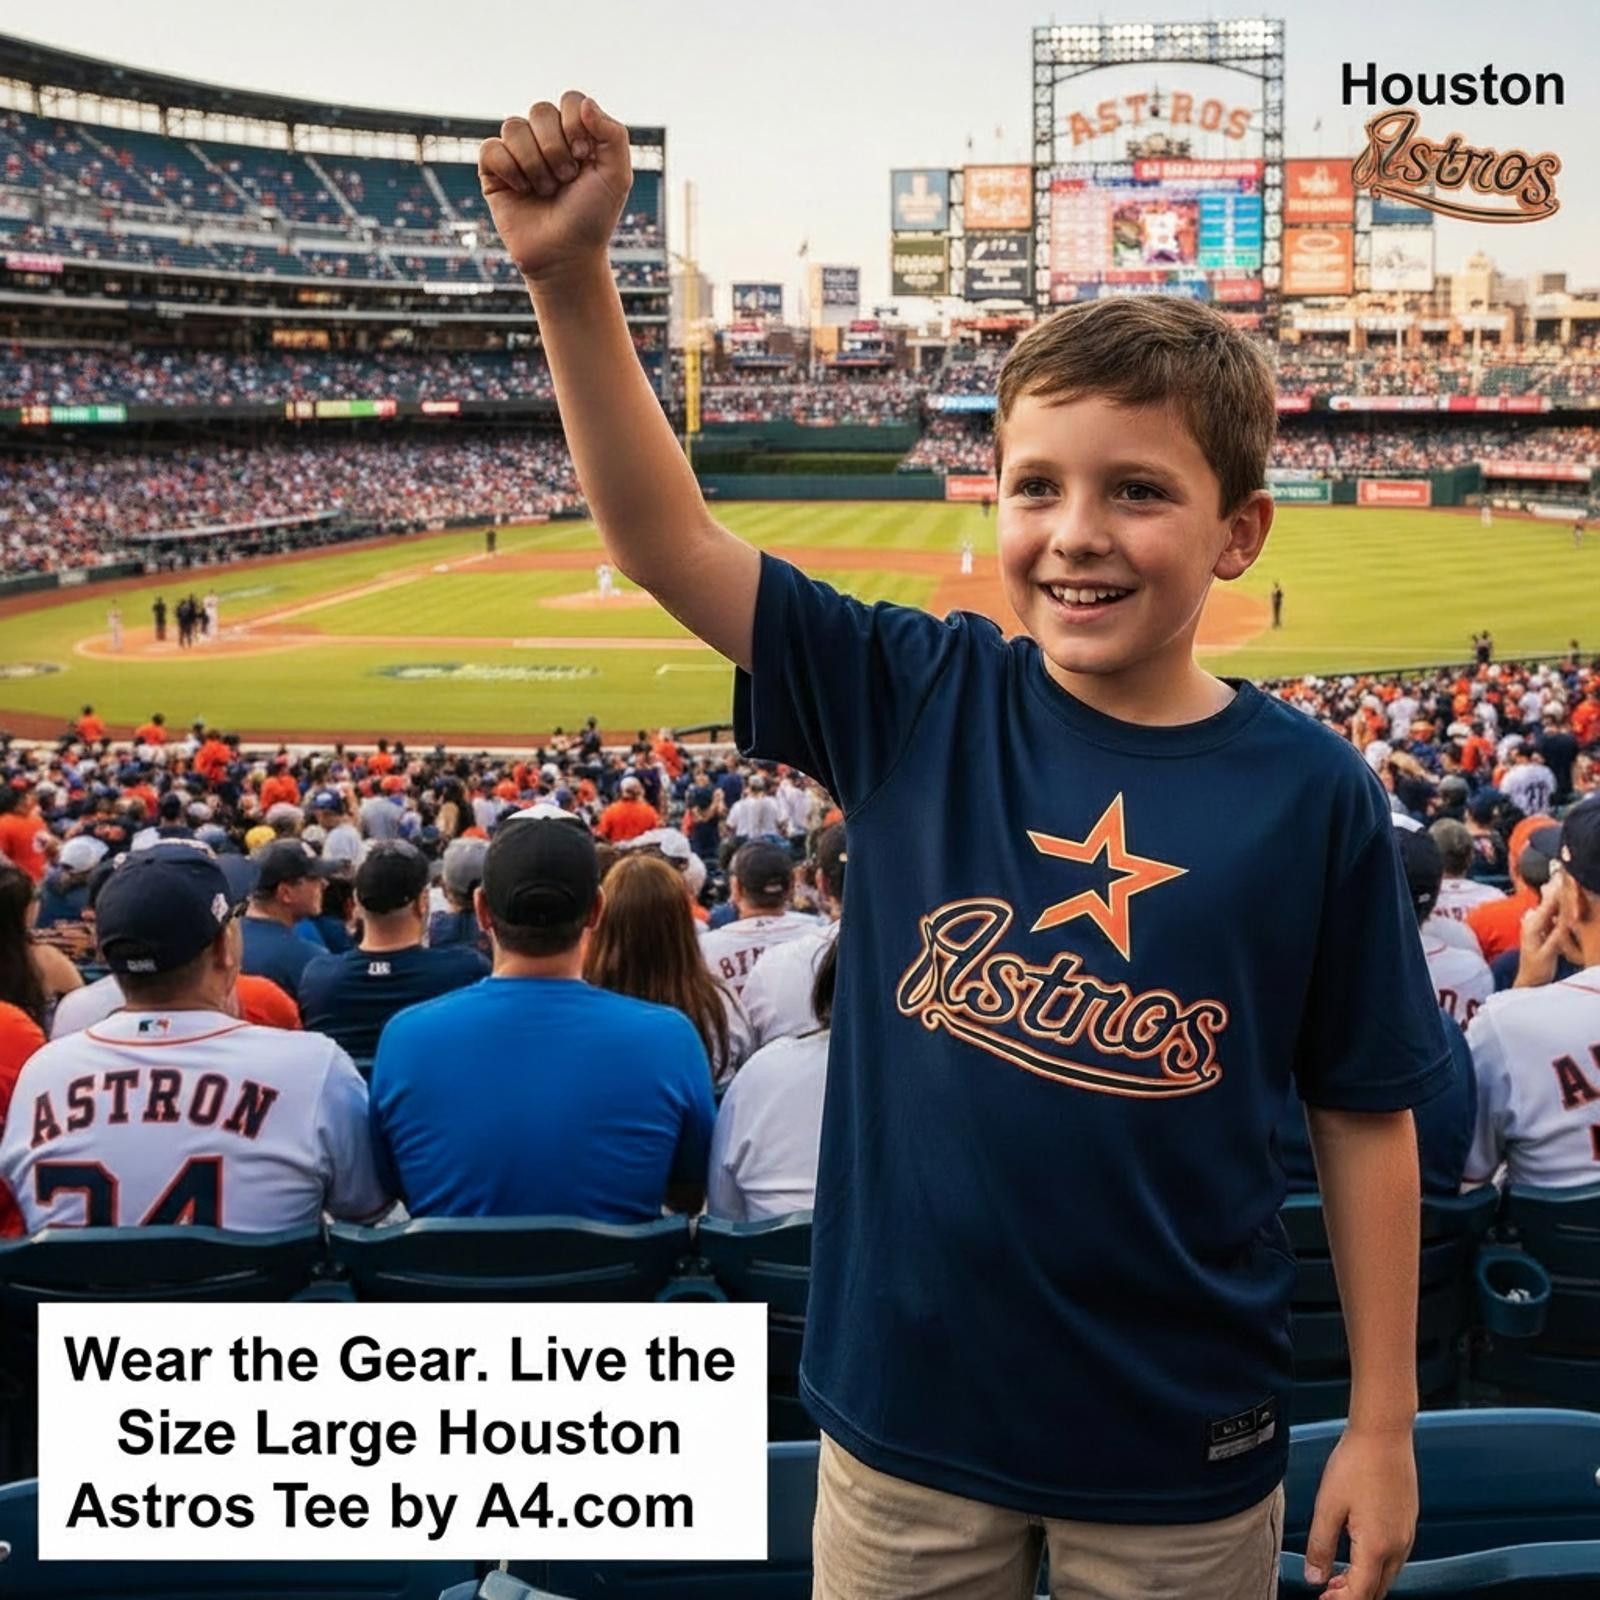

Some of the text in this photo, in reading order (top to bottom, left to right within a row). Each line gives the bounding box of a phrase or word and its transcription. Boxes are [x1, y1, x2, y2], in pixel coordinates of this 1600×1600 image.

[1067, 90, 1252, 146] ASTROS
[897, 896, 1229, 1098] Astros
[30, 1068, 280, 1149] ASTRON
